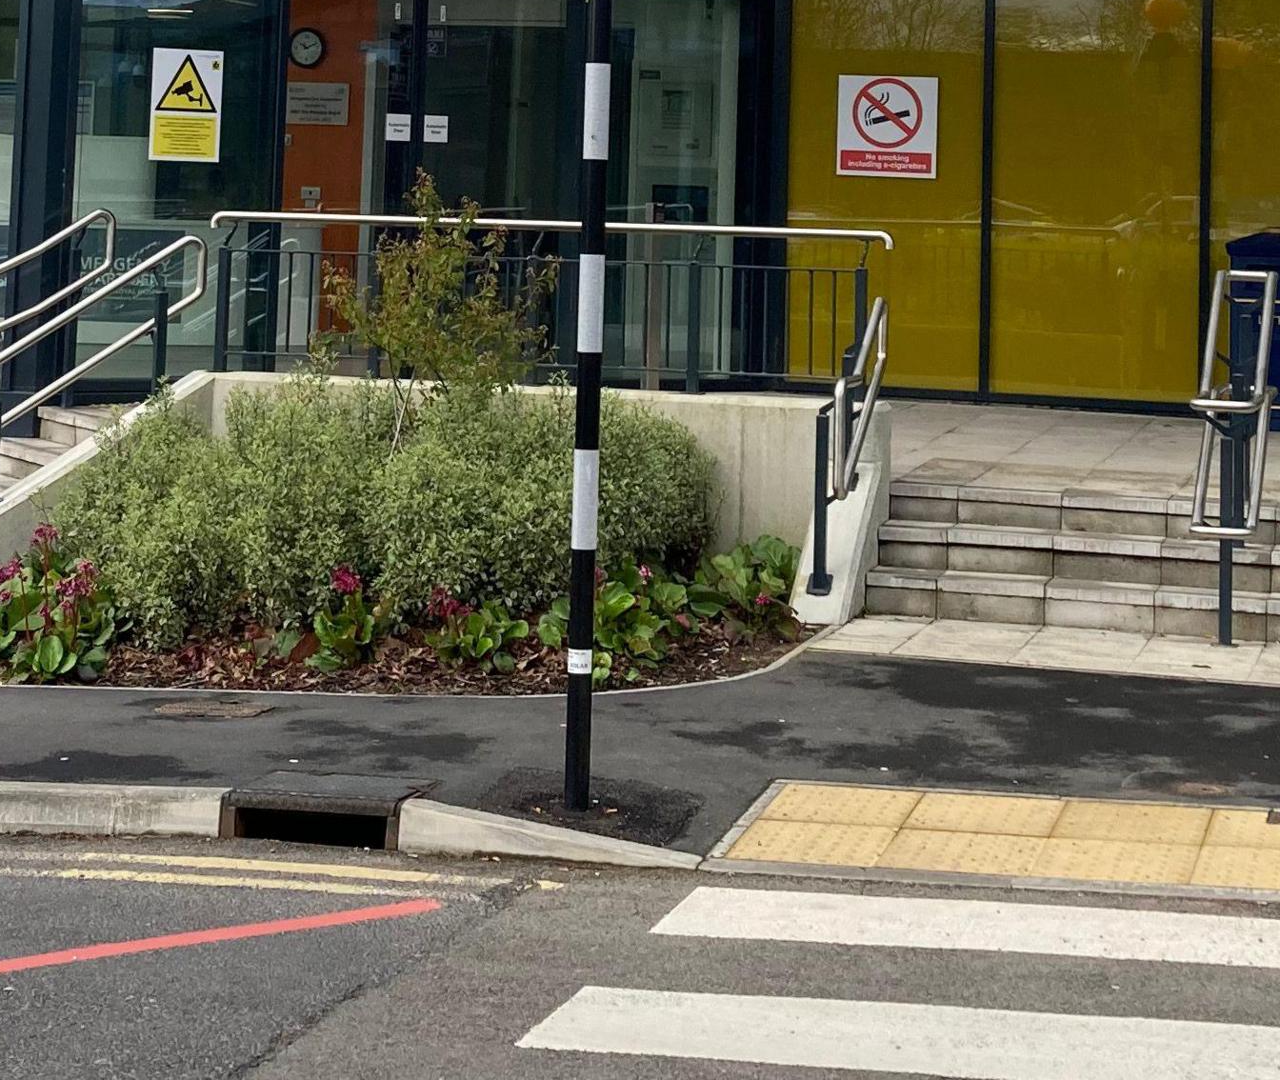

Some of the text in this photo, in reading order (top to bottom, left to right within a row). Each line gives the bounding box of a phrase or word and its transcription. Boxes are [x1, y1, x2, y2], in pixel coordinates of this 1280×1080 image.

[865, 152, 910, 163] No smoking
[848, 160, 882, 169] including
